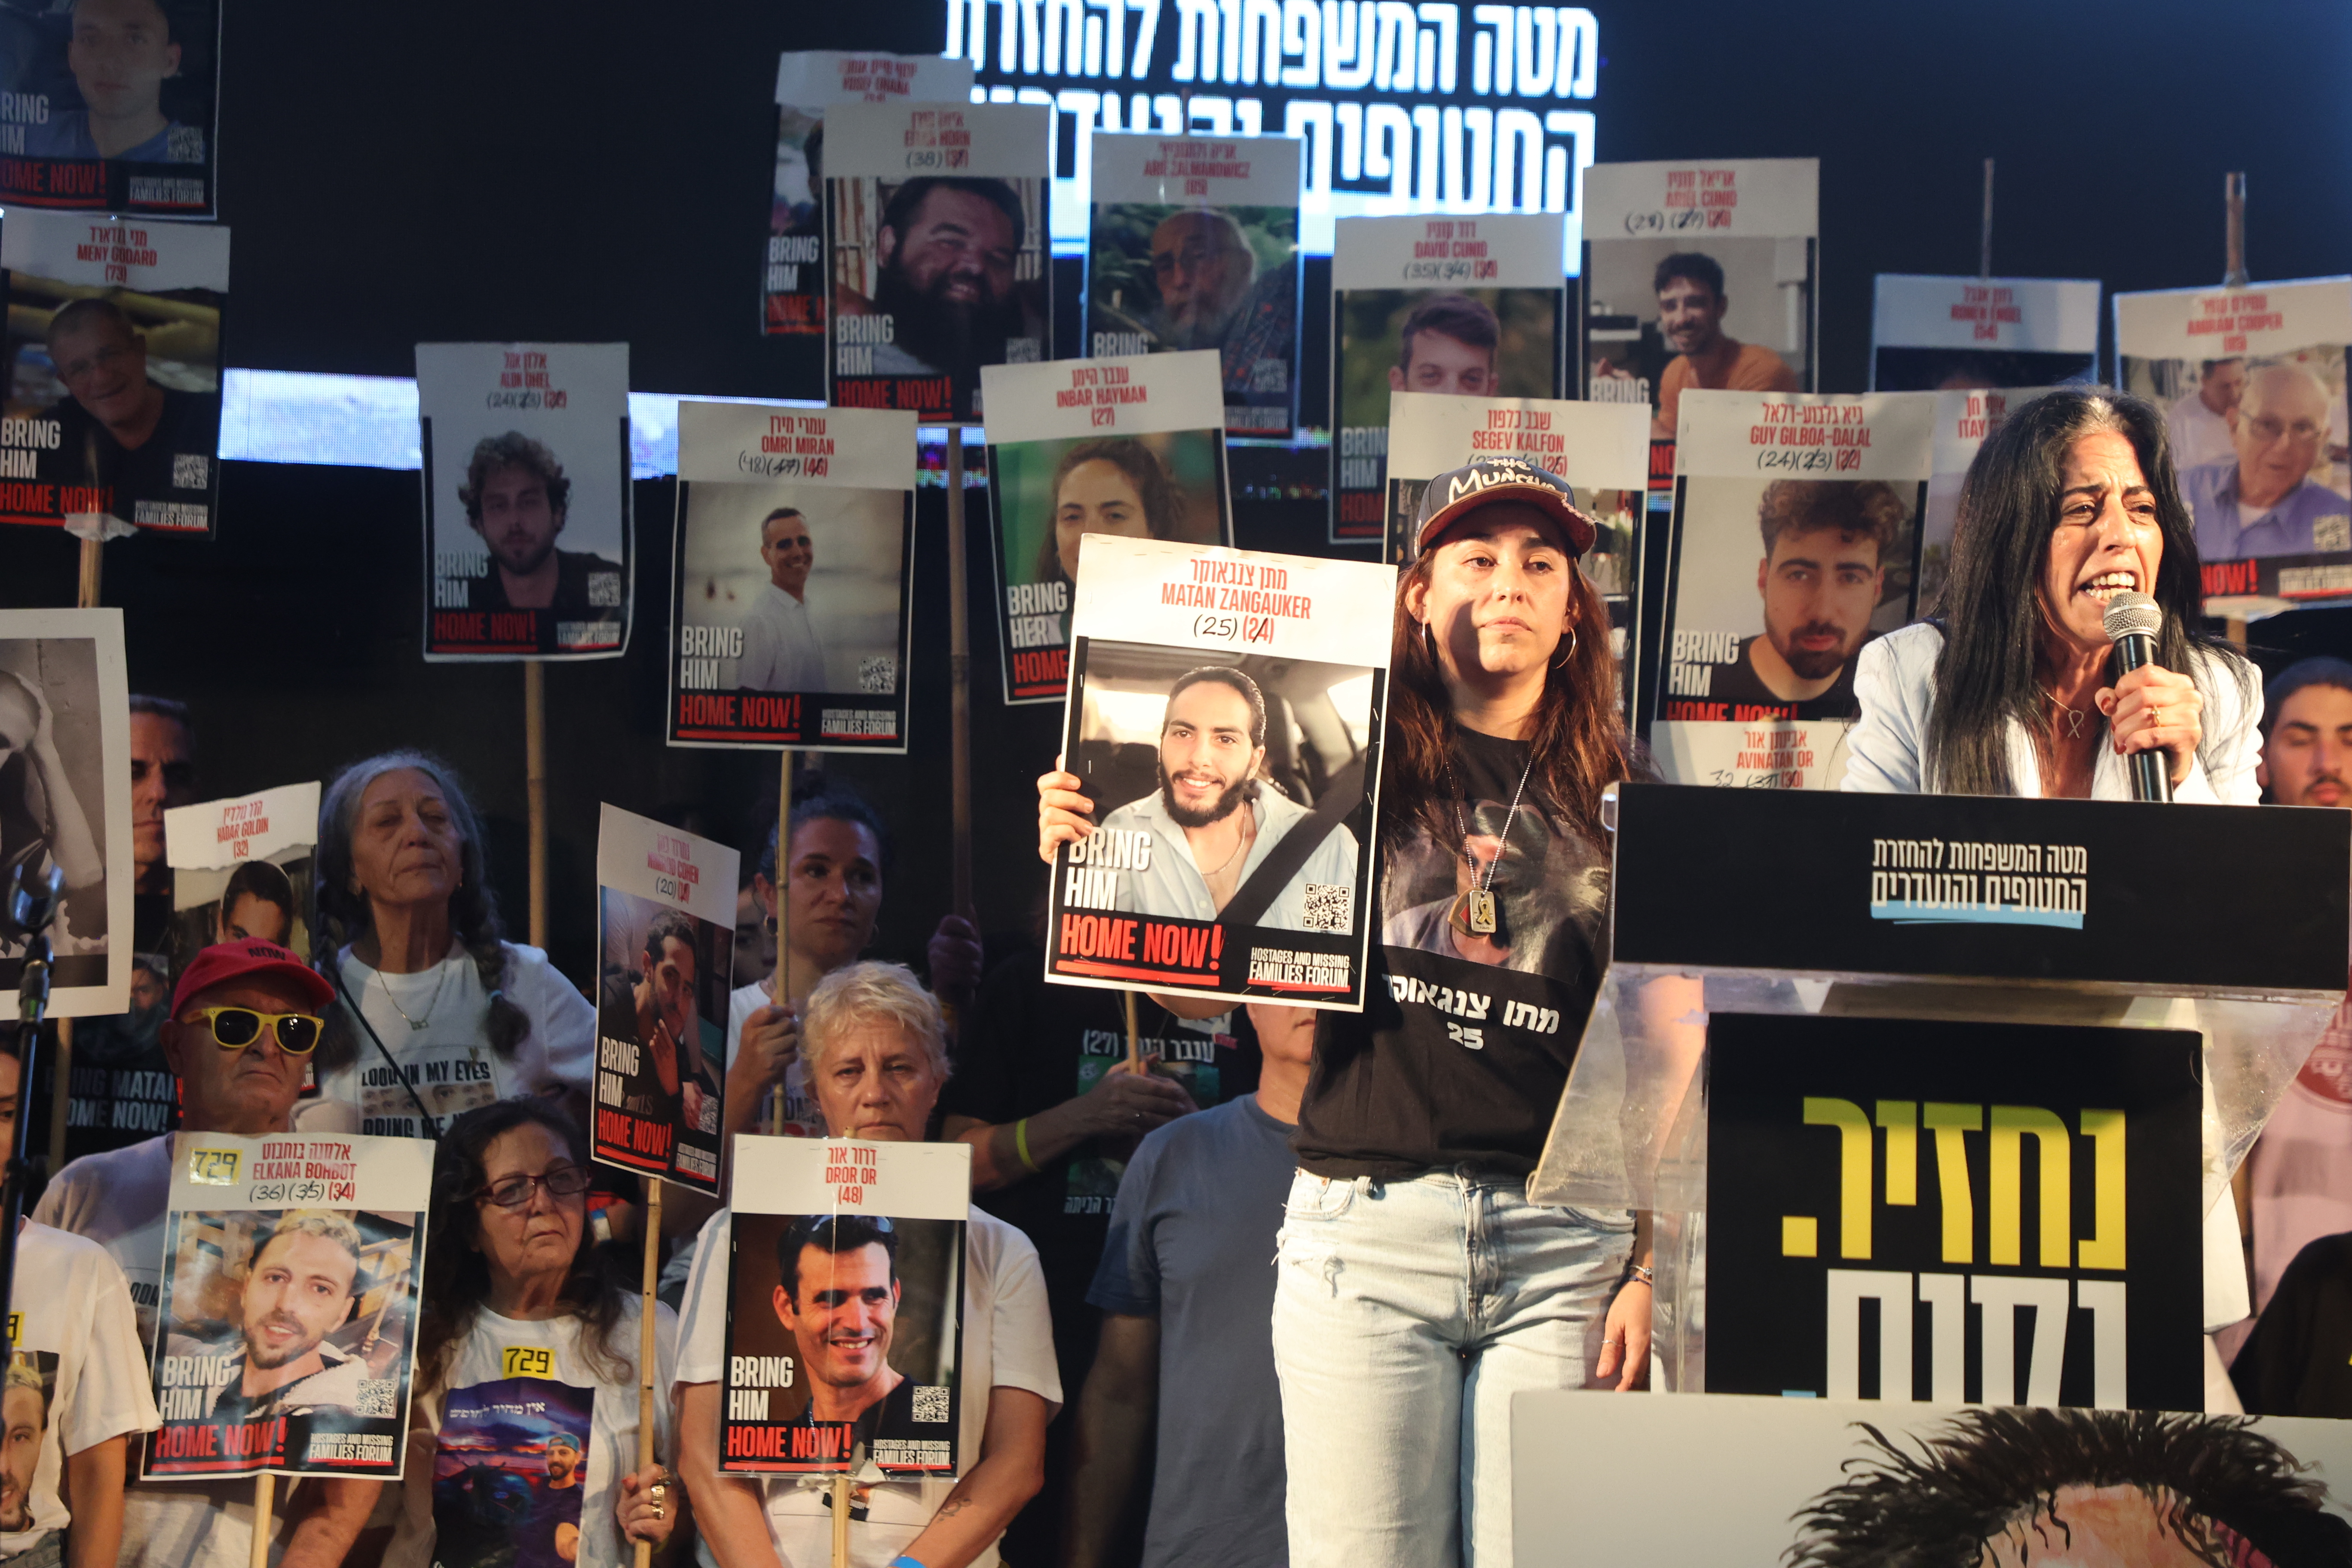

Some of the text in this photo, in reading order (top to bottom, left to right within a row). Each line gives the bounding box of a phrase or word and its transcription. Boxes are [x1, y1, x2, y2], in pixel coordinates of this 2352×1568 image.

[1172, 0, 1459, 94] המשפחות
[1474, 3, 1599, 99] מטה
[0, 91, 49, 125] RING
[0, 126, 25, 156] IM
[0, 159, 44, 192] OME
[50, 160, 107, 194] NOW!
[769, 236, 820, 264] BRING
[1414, 240, 1488, 258] DAVID CUNIO
[767, 264, 799, 292] HIM
[836, 314, 894, 345] BRING
[1093, 332, 1149, 358] BRING
[836, 346, 873, 376] HIM
[836, 380, 891, 409] HOME
[896, 375, 952, 409] NOW!
[1057, 386, 1147, 407] INBAR HAYMAN
[770, 415, 826, 436] עמרי מירן
[1091, 406, 1115, 427] (27)
[1488, 409, 1552, 431] שגב כלפון
[1842, 406, 1863, 425] גיא
[1958, 419, 1986, 439] ITAY
[1, 417, 61, 450] BRING
[761, 435, 835, 456] OMRI MIRAN
[1341, 426, 1389, 456] BRIN
[1473, 430, 1565, 453] SEGEV KALFON
[1750, 426, 1871, 448] GUY GILBOA-DALAL
[0, 449, 37, 480] HIM
[1340, 458, 1378, 488] HIM
[0, 482, 54, 514] HOME
[59, 485, 114, 515] NOW!
[435, 551, 489, 579] BRING
[1190, 558, 1287, 591] מתן צנגאוקר
[434, 579, 469, 609] HIM
[1006, 581, 1068, 616] BRING
[1161, 582, 1311, 619] MATAN ZANGAUKER
[434, 611, 487, 642] HOME
[490, 610, 537, 642] NOW!
[1009, 616, 1050, 649] HER
[1193, 613, 1238, 640] (25)
[681, 625, 743, 658] BRING
[1673, 628, 1740, 665] BRING
[680, 658, 719, 690] HIM
[1013, 649, 1069, 684] HOME
[1668, 663, 1712, 698] HIM
[679, 693, 802, 730] HOME NOW!
[821, 720, 897, 735] FAMILIES FORUM
[1744, 731, 1808, 751] אבינתן אור
[1736, 750, 1814, 769] AVINATAN OR
[217, 817, 269, 844] HADAR GOLDIN
[1069, 826, 1152, 871] BRING
[1872, 837, 2088, 875] מטה המשפחות להחזרת
[656, 876, 677, 899] (20)
[1064, 866, 1118, 911] HIM
[1871, 871, 2087, 915] החטופים והנעדרים
[1060, 913, 1224, 971] HOME NOW!
[1251, 947, 1350, 968] HOSTAGES AND MISSING
[1248, 961, 1349, 988] FAMILIES FORUM
[1381, 973, 1560, 1035] מתן צנגאוקר
[1082, 1029, 1119, 1057] (27)
[1447, 1021, 1484, 1050] 25
[601, 1035, 640, 1077] BRING
[1170, 1039, 1215, 1064] ענבר
[426, 1060, 449, 1082] MY
[456, 1060, 491, 1081] EYES
[598, 1070, 624, 1108] HIM
[112, 1100, 169, 1133] NOW!
[597, 1109, 632, 1148] HOME
[633, 1118, 673, 1158] NOW!
[194, 1151, 238, 1179] 729
[262, 1142, 305, 1160] בוחבוט
[827, 1147, 877, 1166] דרור אור
[253, 1161, 357, 1180] ELKANA BOHBOT
[825, 1166, 877, 1185] DROR OR
[1782, 1096, 2126, 1270] נחזיר.
[250, 1183, 285, 1203] (36)
[838, 1185, 863, 1205] (48)
[1782, 1269, 2127, 1411] נקום
[162, 1355, 232, 1387] BRING
[506, 1348, 550, 1374] 729
[730, 1355, 794, 1388] BRING
[160, 1389, 202, 1421] HIM
[728, 1389, 770, 1421] HIM
[155, 1416, 288, 1458] HOME NOW!
[310, 1432, 394, 1447] HOSTAGES AND MISSING
[727, 1423, 854, 1459] HOME NOW!
[873, 1438, 951, 1452] HOSTAGES AND MISSING
[309, 1443, 393, 1462] FAMILIES FORUM
[872, 1449, 950, 1467] FAMILIES FORUM
